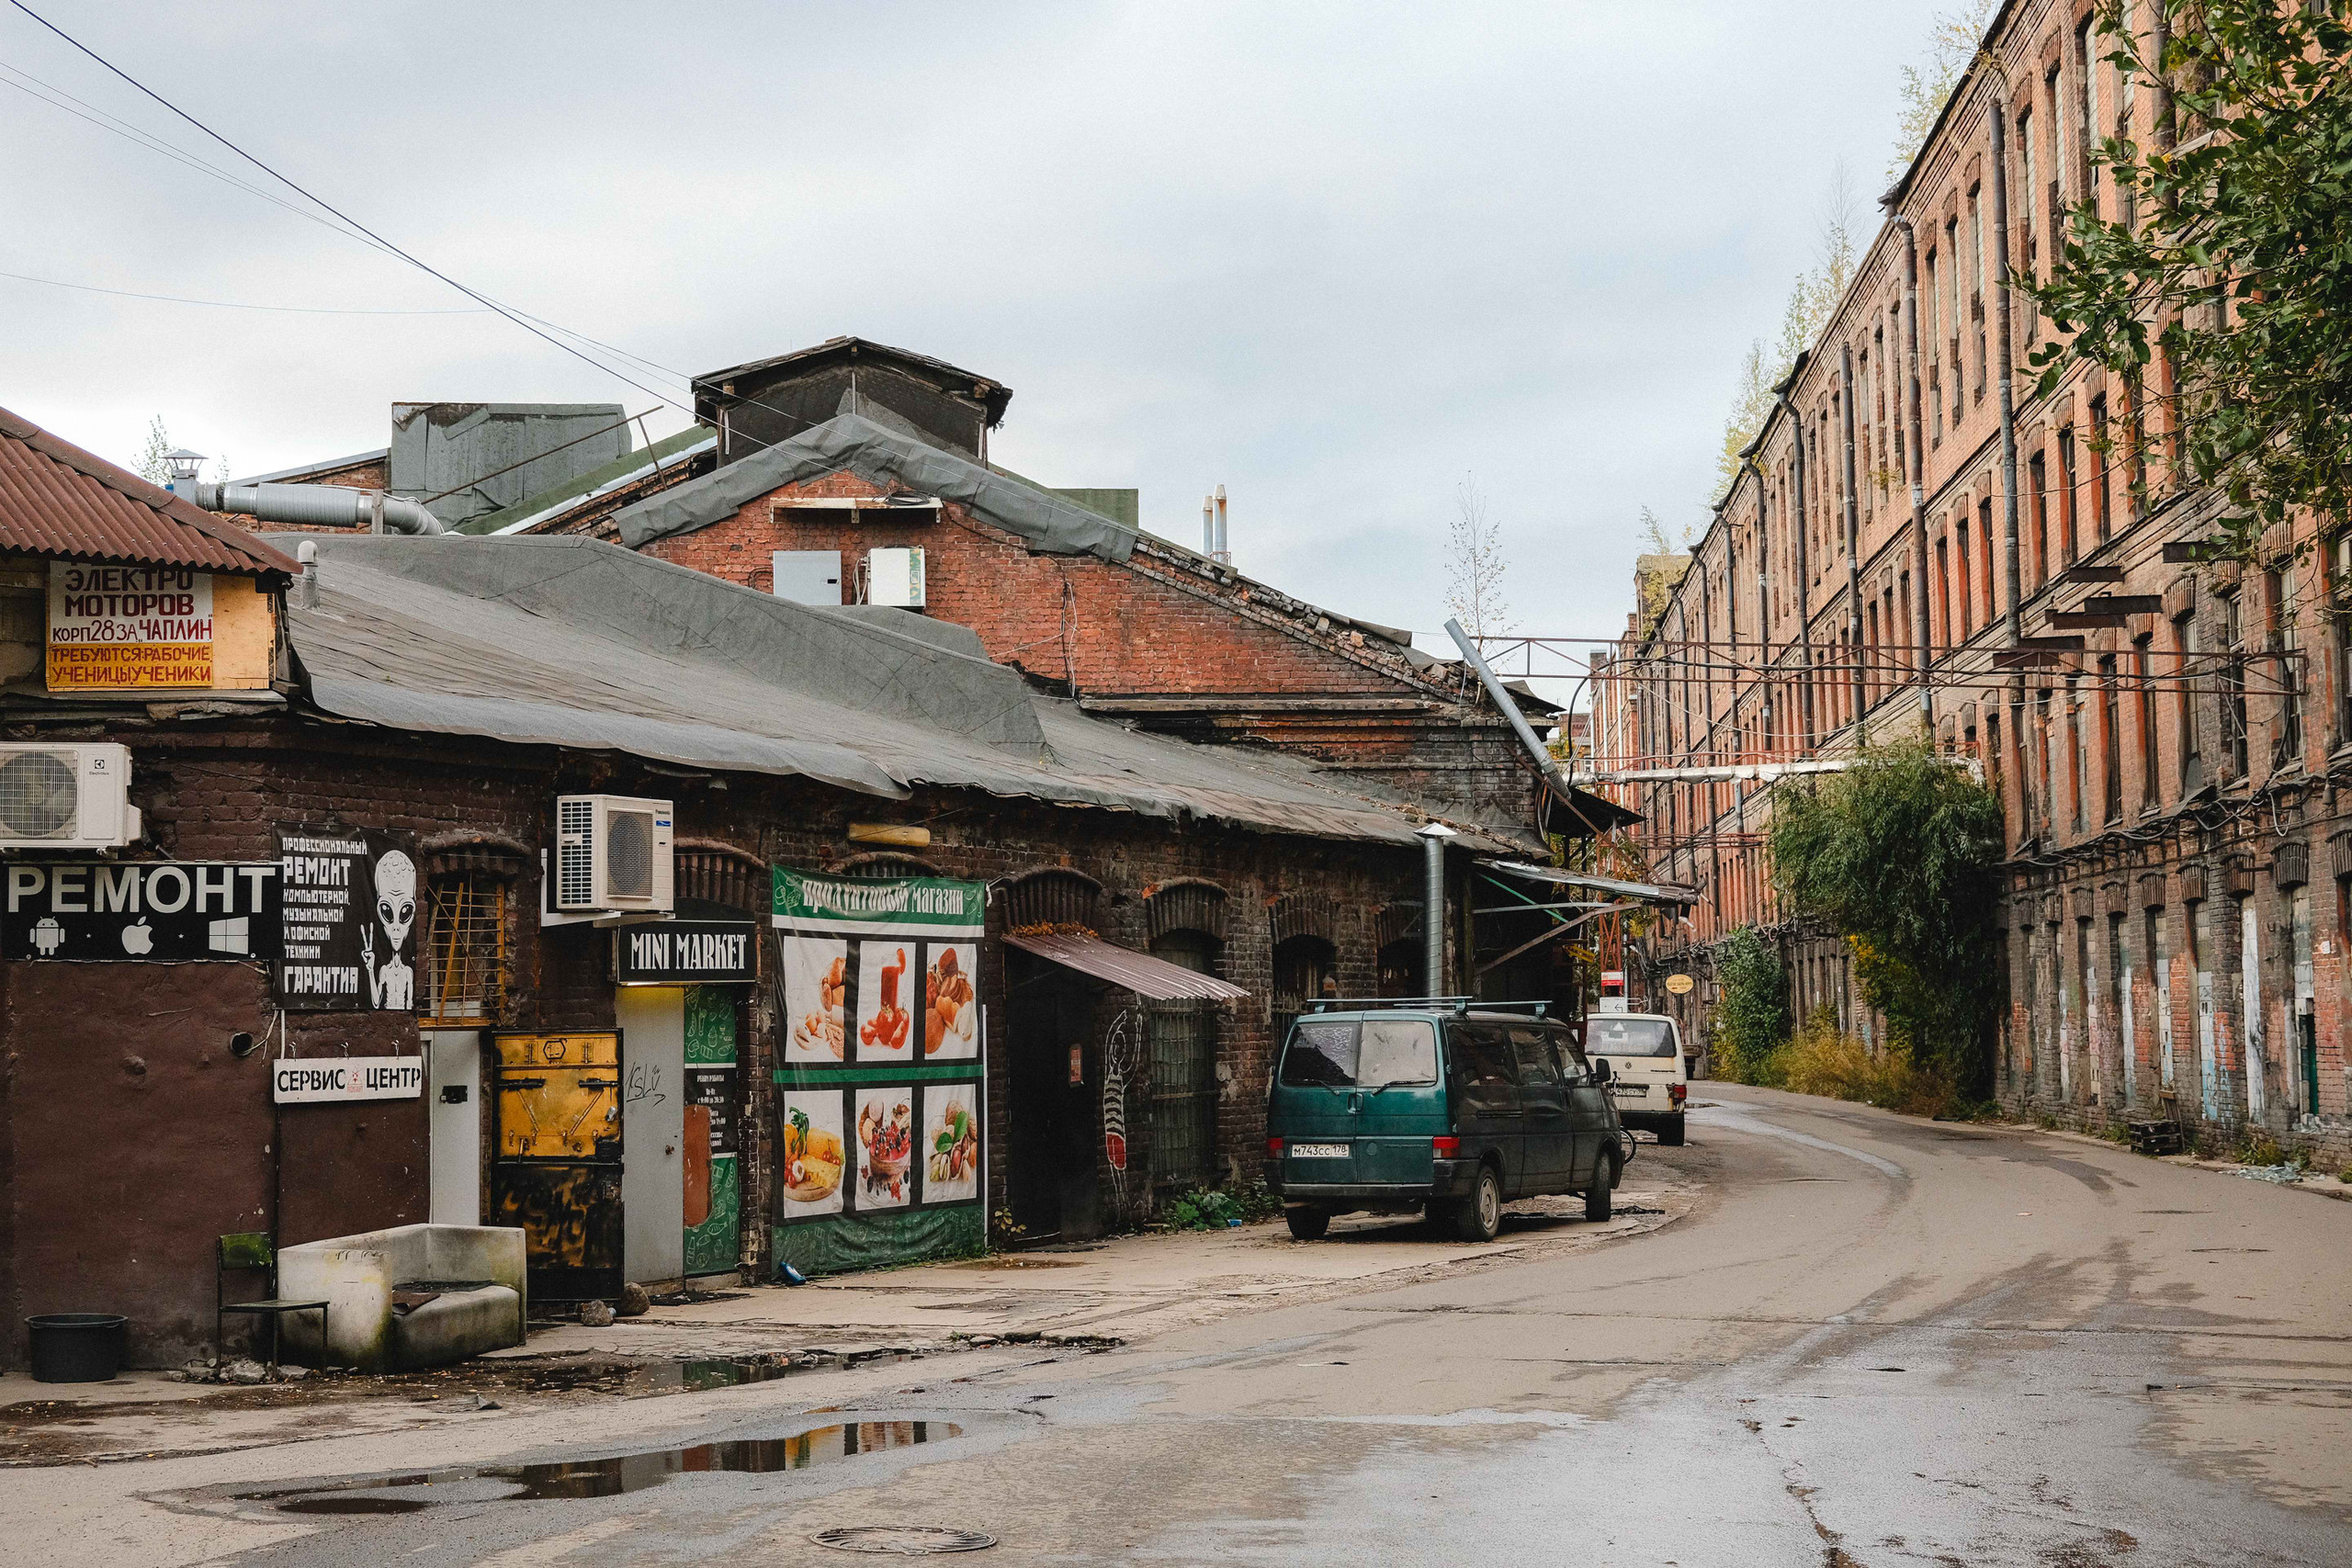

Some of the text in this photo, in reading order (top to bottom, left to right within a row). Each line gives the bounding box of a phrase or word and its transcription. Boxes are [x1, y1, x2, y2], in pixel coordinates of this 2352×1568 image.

[65, 568, 194, 592] ЭЛЕКТРО
[64, 593, 195, 617] МОТОРОВ
[132, 666, 211, 682] УЧЕНИКИ
[282, 837, 368, 855] ПРОФЕССИОНАЛЬНЫЙ
[283, 855, 351, 886] РЕМОНТ
[7, 865, 276, 914] РЕМОНТ
[283, 906, 345, 922] МУЗЫКАЛЬНОЙ
[284, 924, 331, 941] И ОФИСНОЙ
[284, 944, 321, 959] ТЕХНИКИ
[630, 932, 747, 970] MINI MARKET
[284, 966, 359, 994] ГАРАНТИЯ
[277, 1067, 422, 1092] СЕРВИС ЦЕНТР
